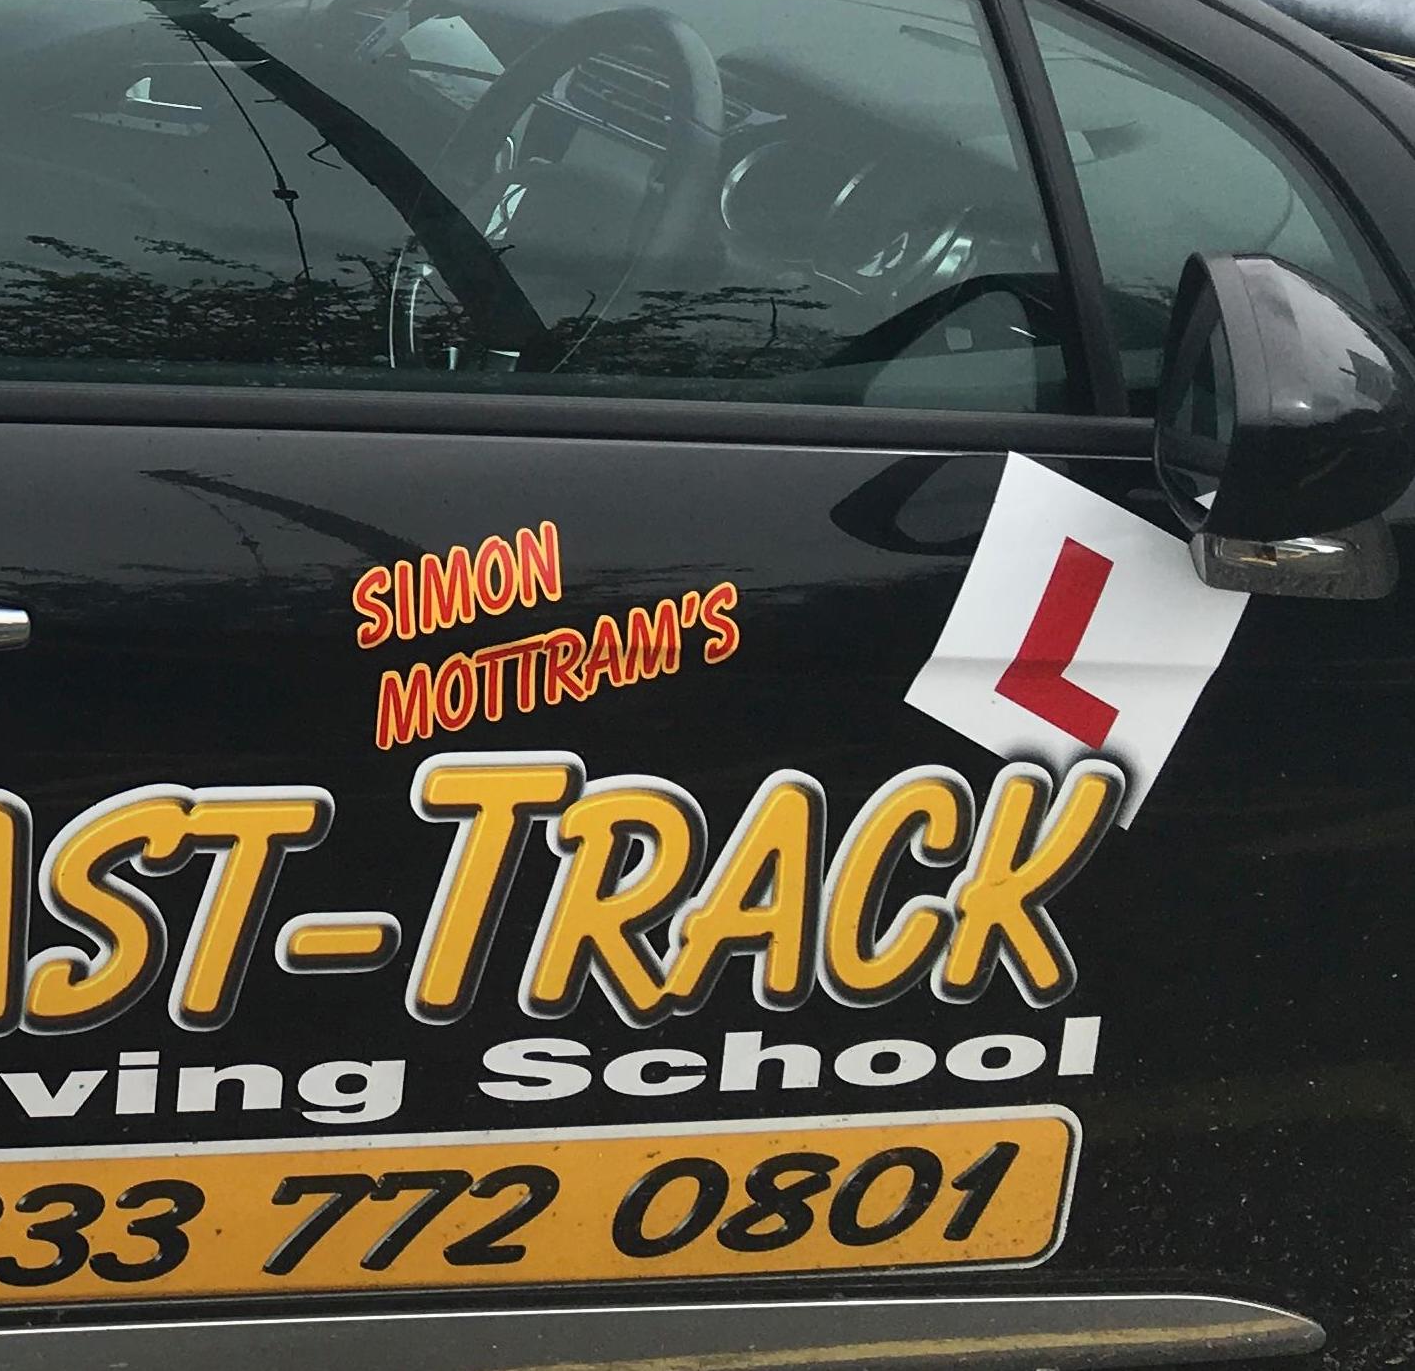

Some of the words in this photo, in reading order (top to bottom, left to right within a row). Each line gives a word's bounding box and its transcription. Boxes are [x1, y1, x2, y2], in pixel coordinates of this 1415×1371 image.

[353, 520, 562, 649] SIMON
[994, 536, 1120, 751] L
[376, 581, 740, 750] MOTTRAM'S
[478, 1016, 1102, 1101] School
[262, 1164, 560, 1276] 772
[611, 1140, 1020, 1258] 0801
